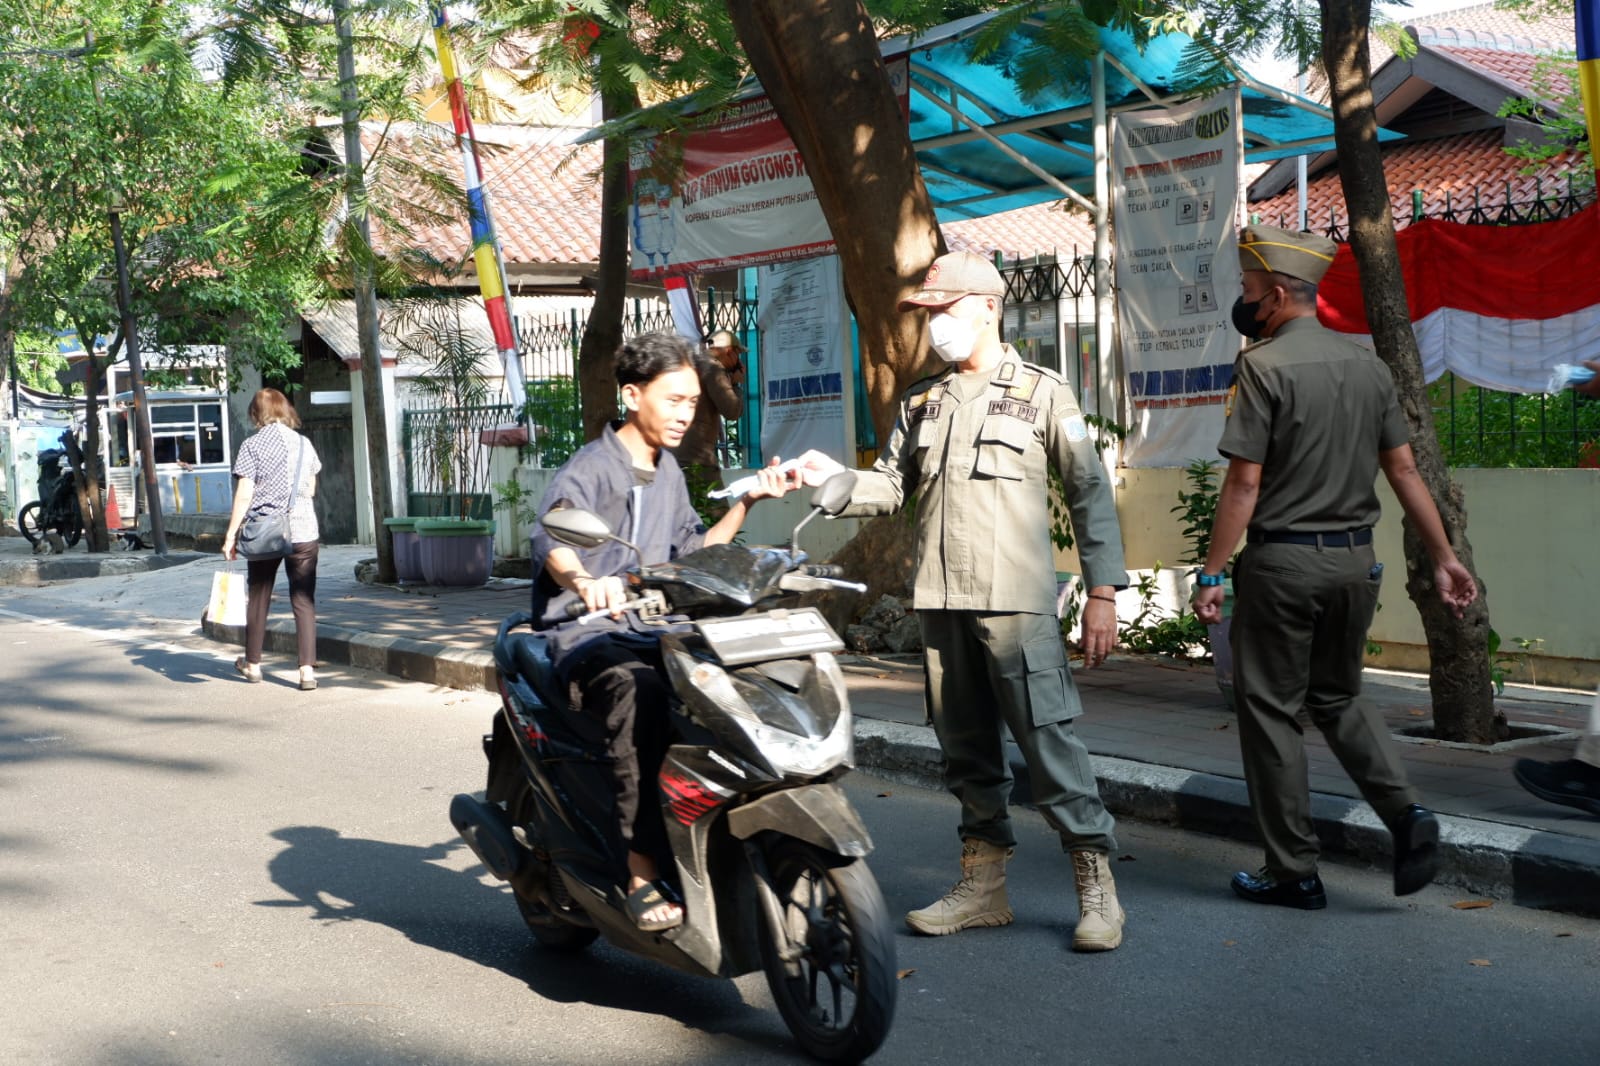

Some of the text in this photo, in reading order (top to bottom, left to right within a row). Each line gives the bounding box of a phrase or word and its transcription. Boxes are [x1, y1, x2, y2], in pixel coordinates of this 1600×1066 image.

[1196, 107, 1229, 138] GRATIS
[681, 181, 699, 209] AIR
[700, 165, 741, 200] MINUM
[741, 153, 794, 186] GOTONG
[685, 210, 709, 223] KOPERASI
[711, 204, 751, 219] KELURAHAN
[751, 199, 775, 212] MERAH
[775, 195, 796, 209] PUTIH
[1183, 203, 1191, 214] P
[1185, 294, 1192, 303] P
